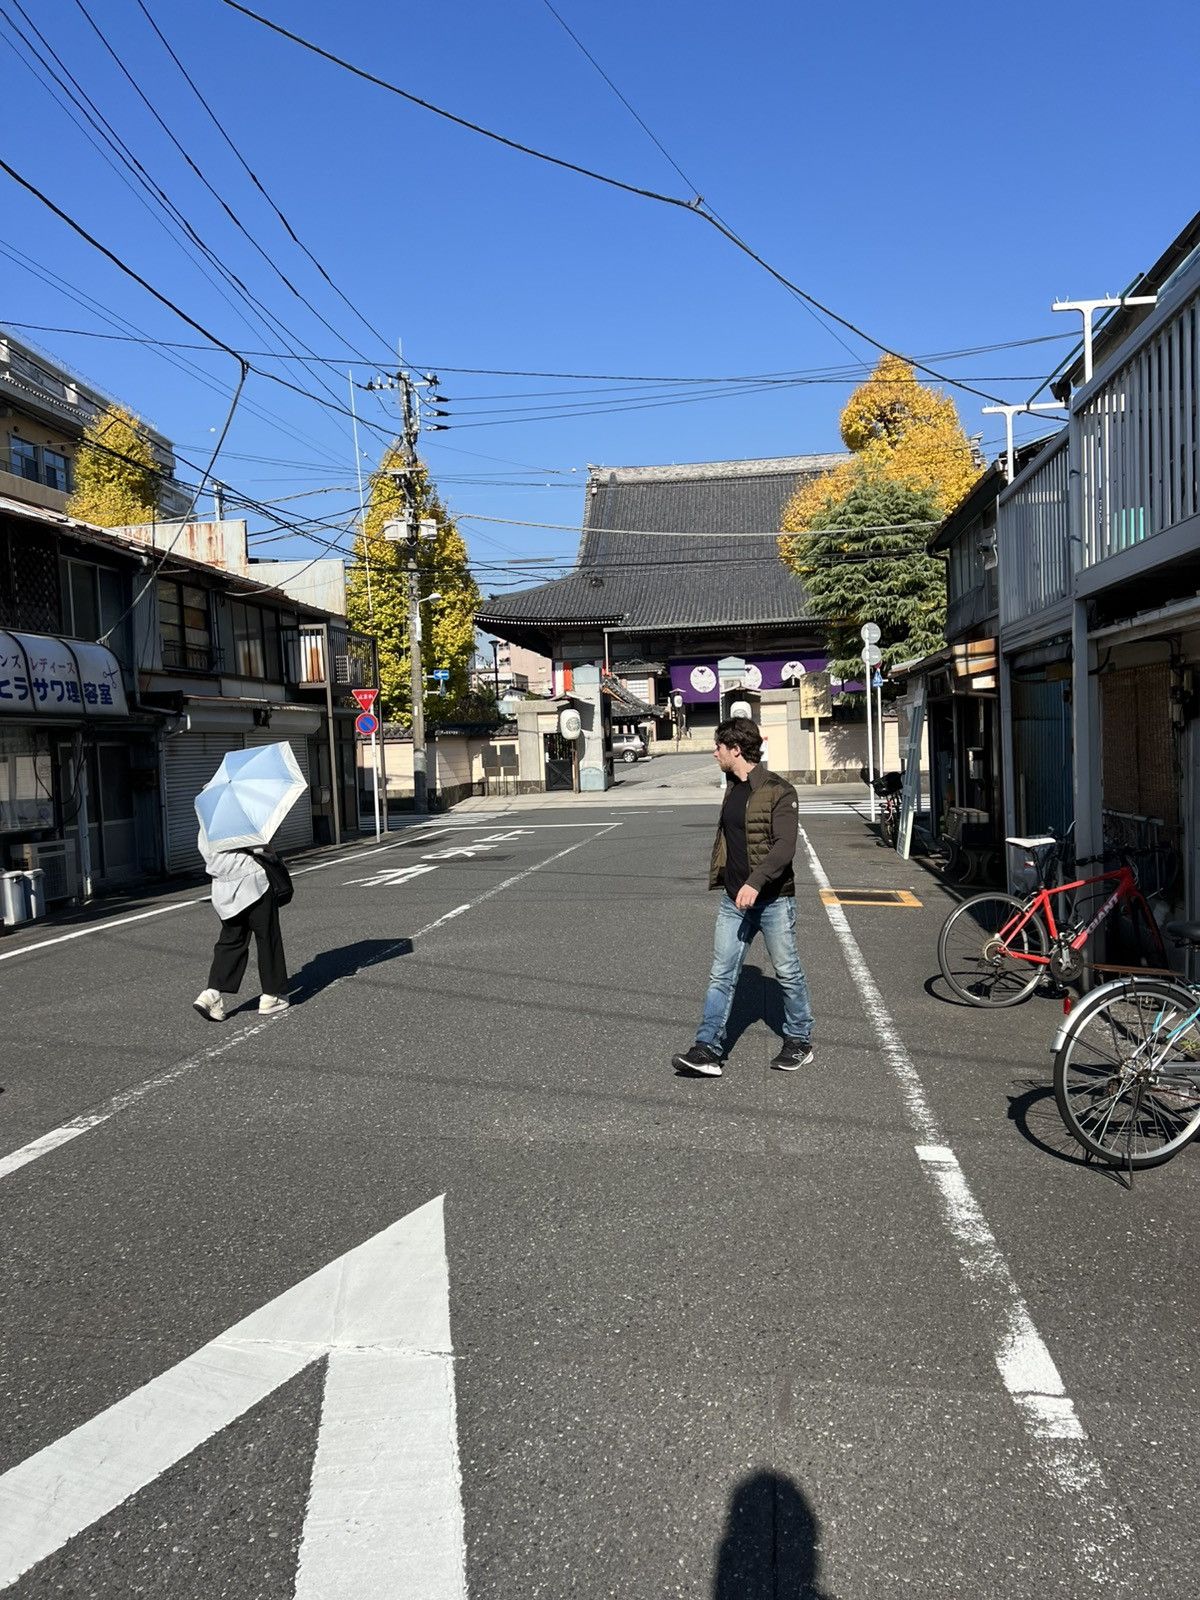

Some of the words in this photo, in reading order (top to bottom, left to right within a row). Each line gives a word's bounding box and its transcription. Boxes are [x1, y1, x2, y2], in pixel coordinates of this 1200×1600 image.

[30, 656, 76, 674] レディース
[0, 676, 114, 705] ヒラサワ理容室
[342, 829, 536, 887] 止まれ
[1086, 892, 1118, 935] GIANT
